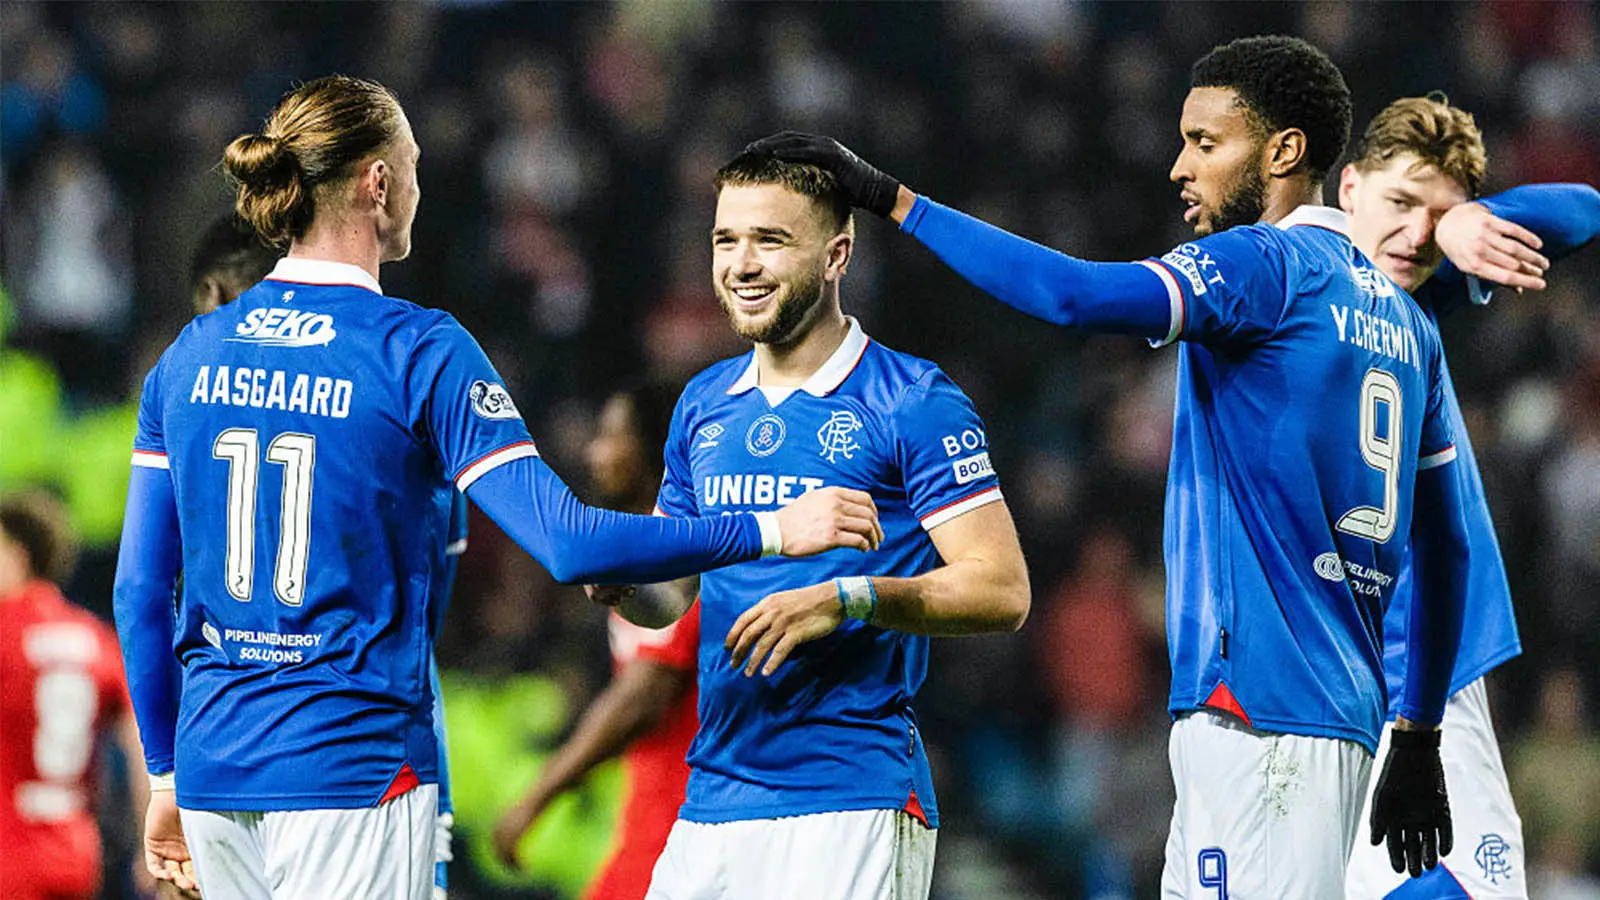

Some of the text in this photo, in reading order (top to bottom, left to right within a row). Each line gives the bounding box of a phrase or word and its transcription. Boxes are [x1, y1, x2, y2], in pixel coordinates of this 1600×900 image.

[236, 307, 336, 346] SEKO
[190, 365, 353, 419] AASGAARD
[1335, 367, 1401, 544] 9
[704, 474, 824, 506] UNIBET
[213, 428, 316, 607] 11
[1197, 848, 1228, 900] 9
